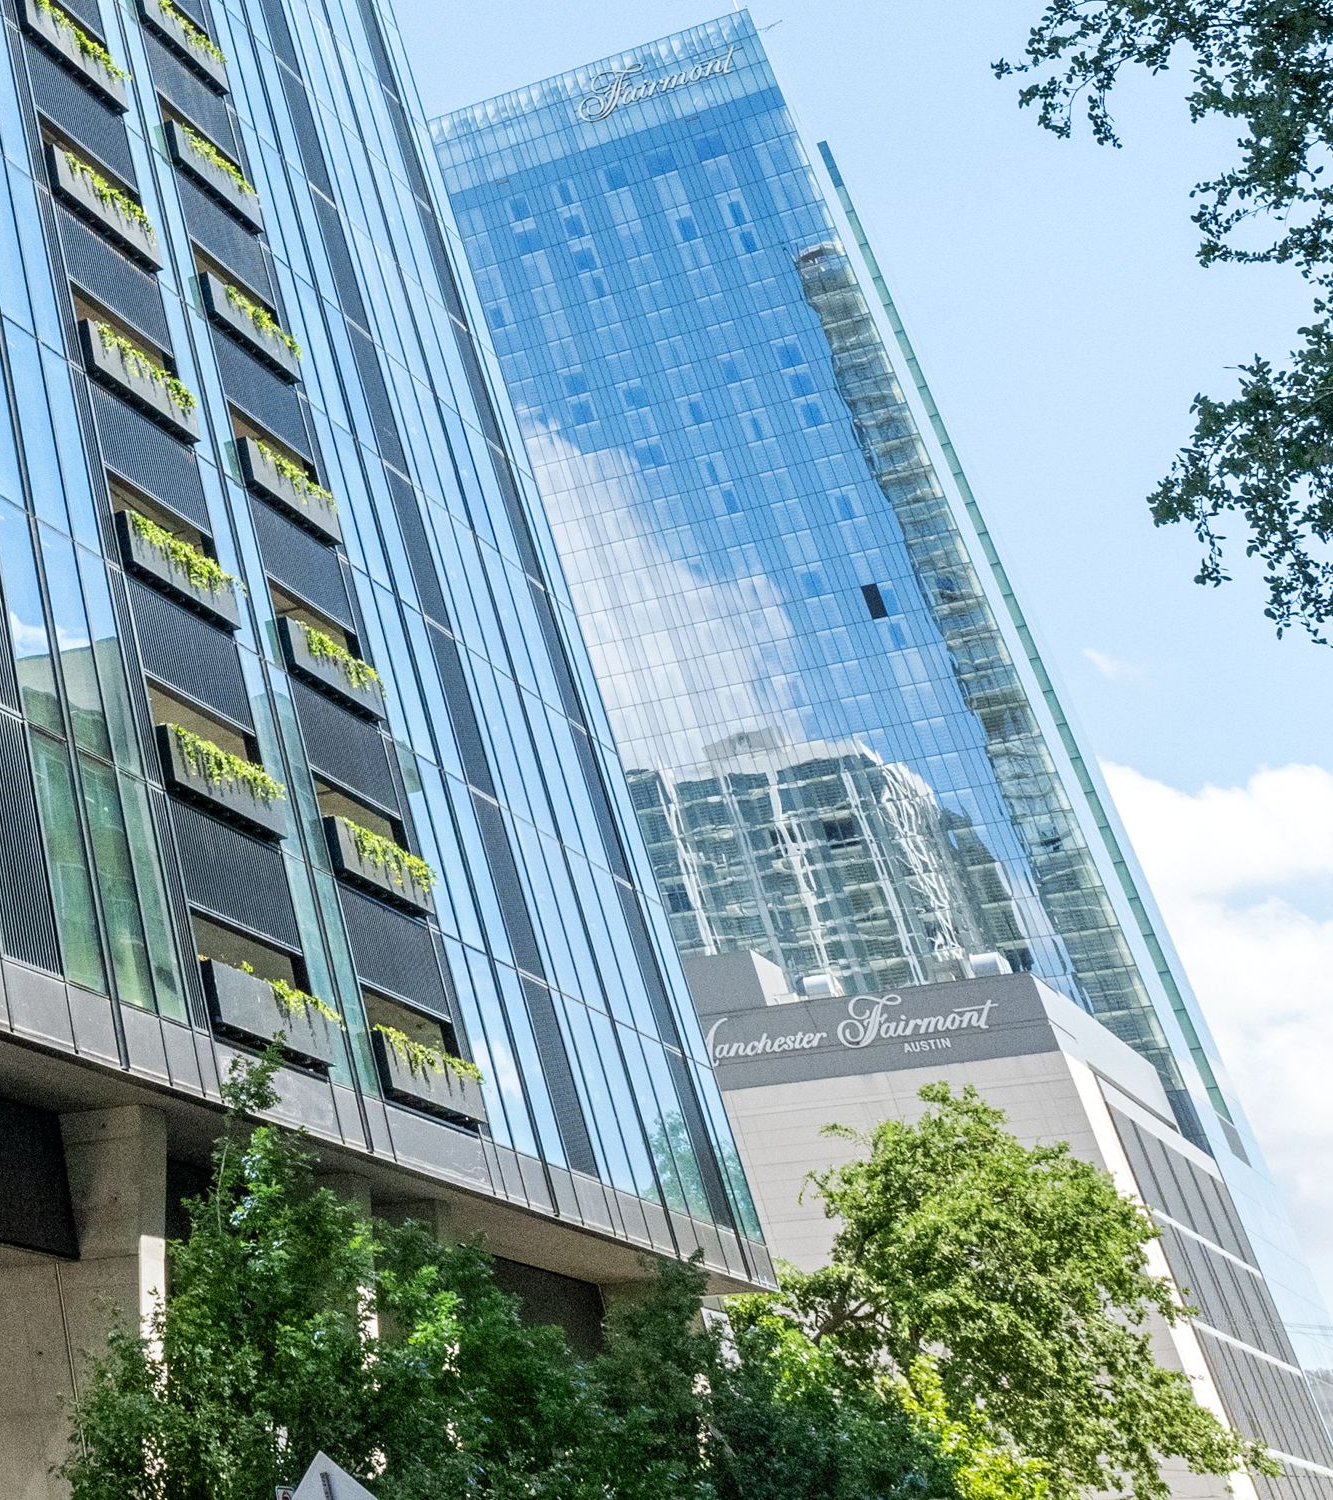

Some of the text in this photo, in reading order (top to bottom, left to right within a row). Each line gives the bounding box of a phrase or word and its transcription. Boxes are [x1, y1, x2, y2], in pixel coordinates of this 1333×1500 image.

[578, 45, 744, 123] Fairmont
[836, 993, 999, 1049] Fairmont
[903, 1037, 952, 1054] AUSTIN
